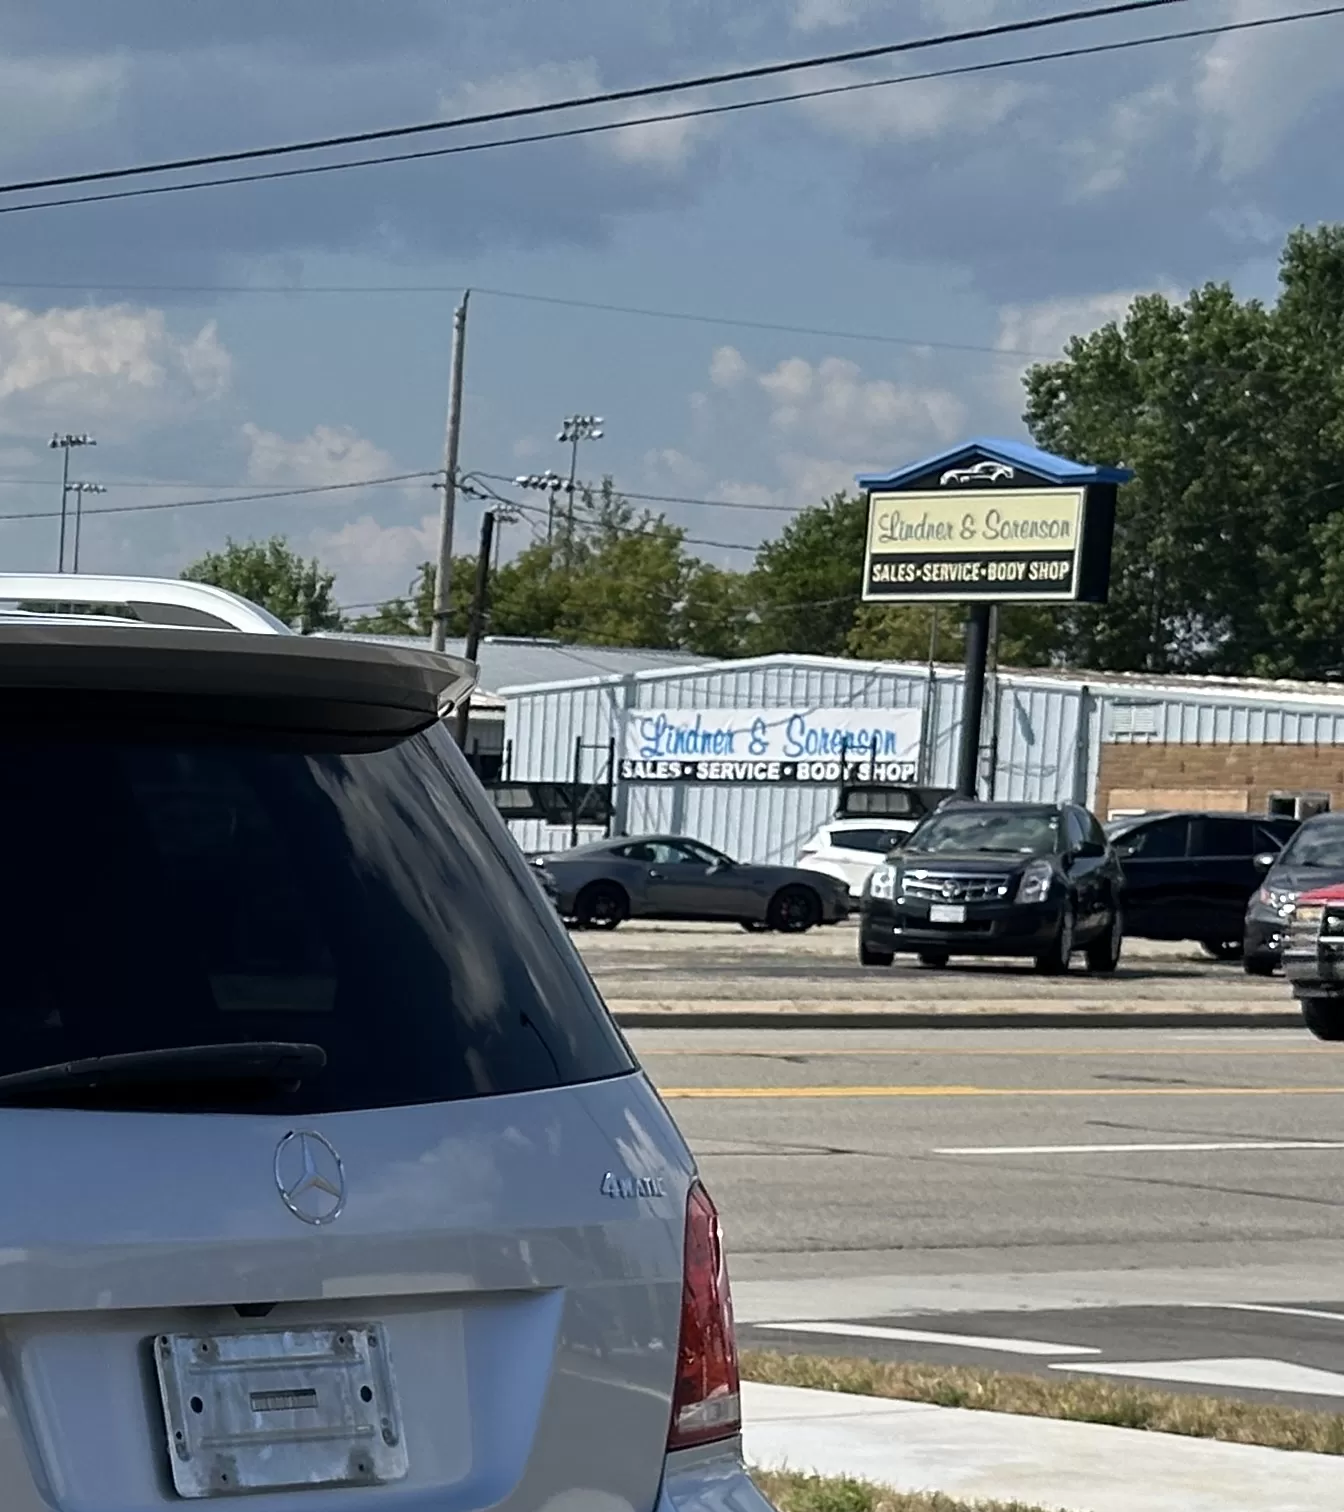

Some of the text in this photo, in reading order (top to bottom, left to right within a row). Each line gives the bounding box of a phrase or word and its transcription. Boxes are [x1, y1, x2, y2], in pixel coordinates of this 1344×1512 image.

[878, 508, 1070, 542] Lindner & Sorenson
[1029, 560, 1069, 580] SHOP
[638, 713, 897, 757] Lindner & Sorenson
[621, 761, 919, 782] SALES SERVICE BODY SHOP
[600, 1171, 667, 1198] 4MATIC
